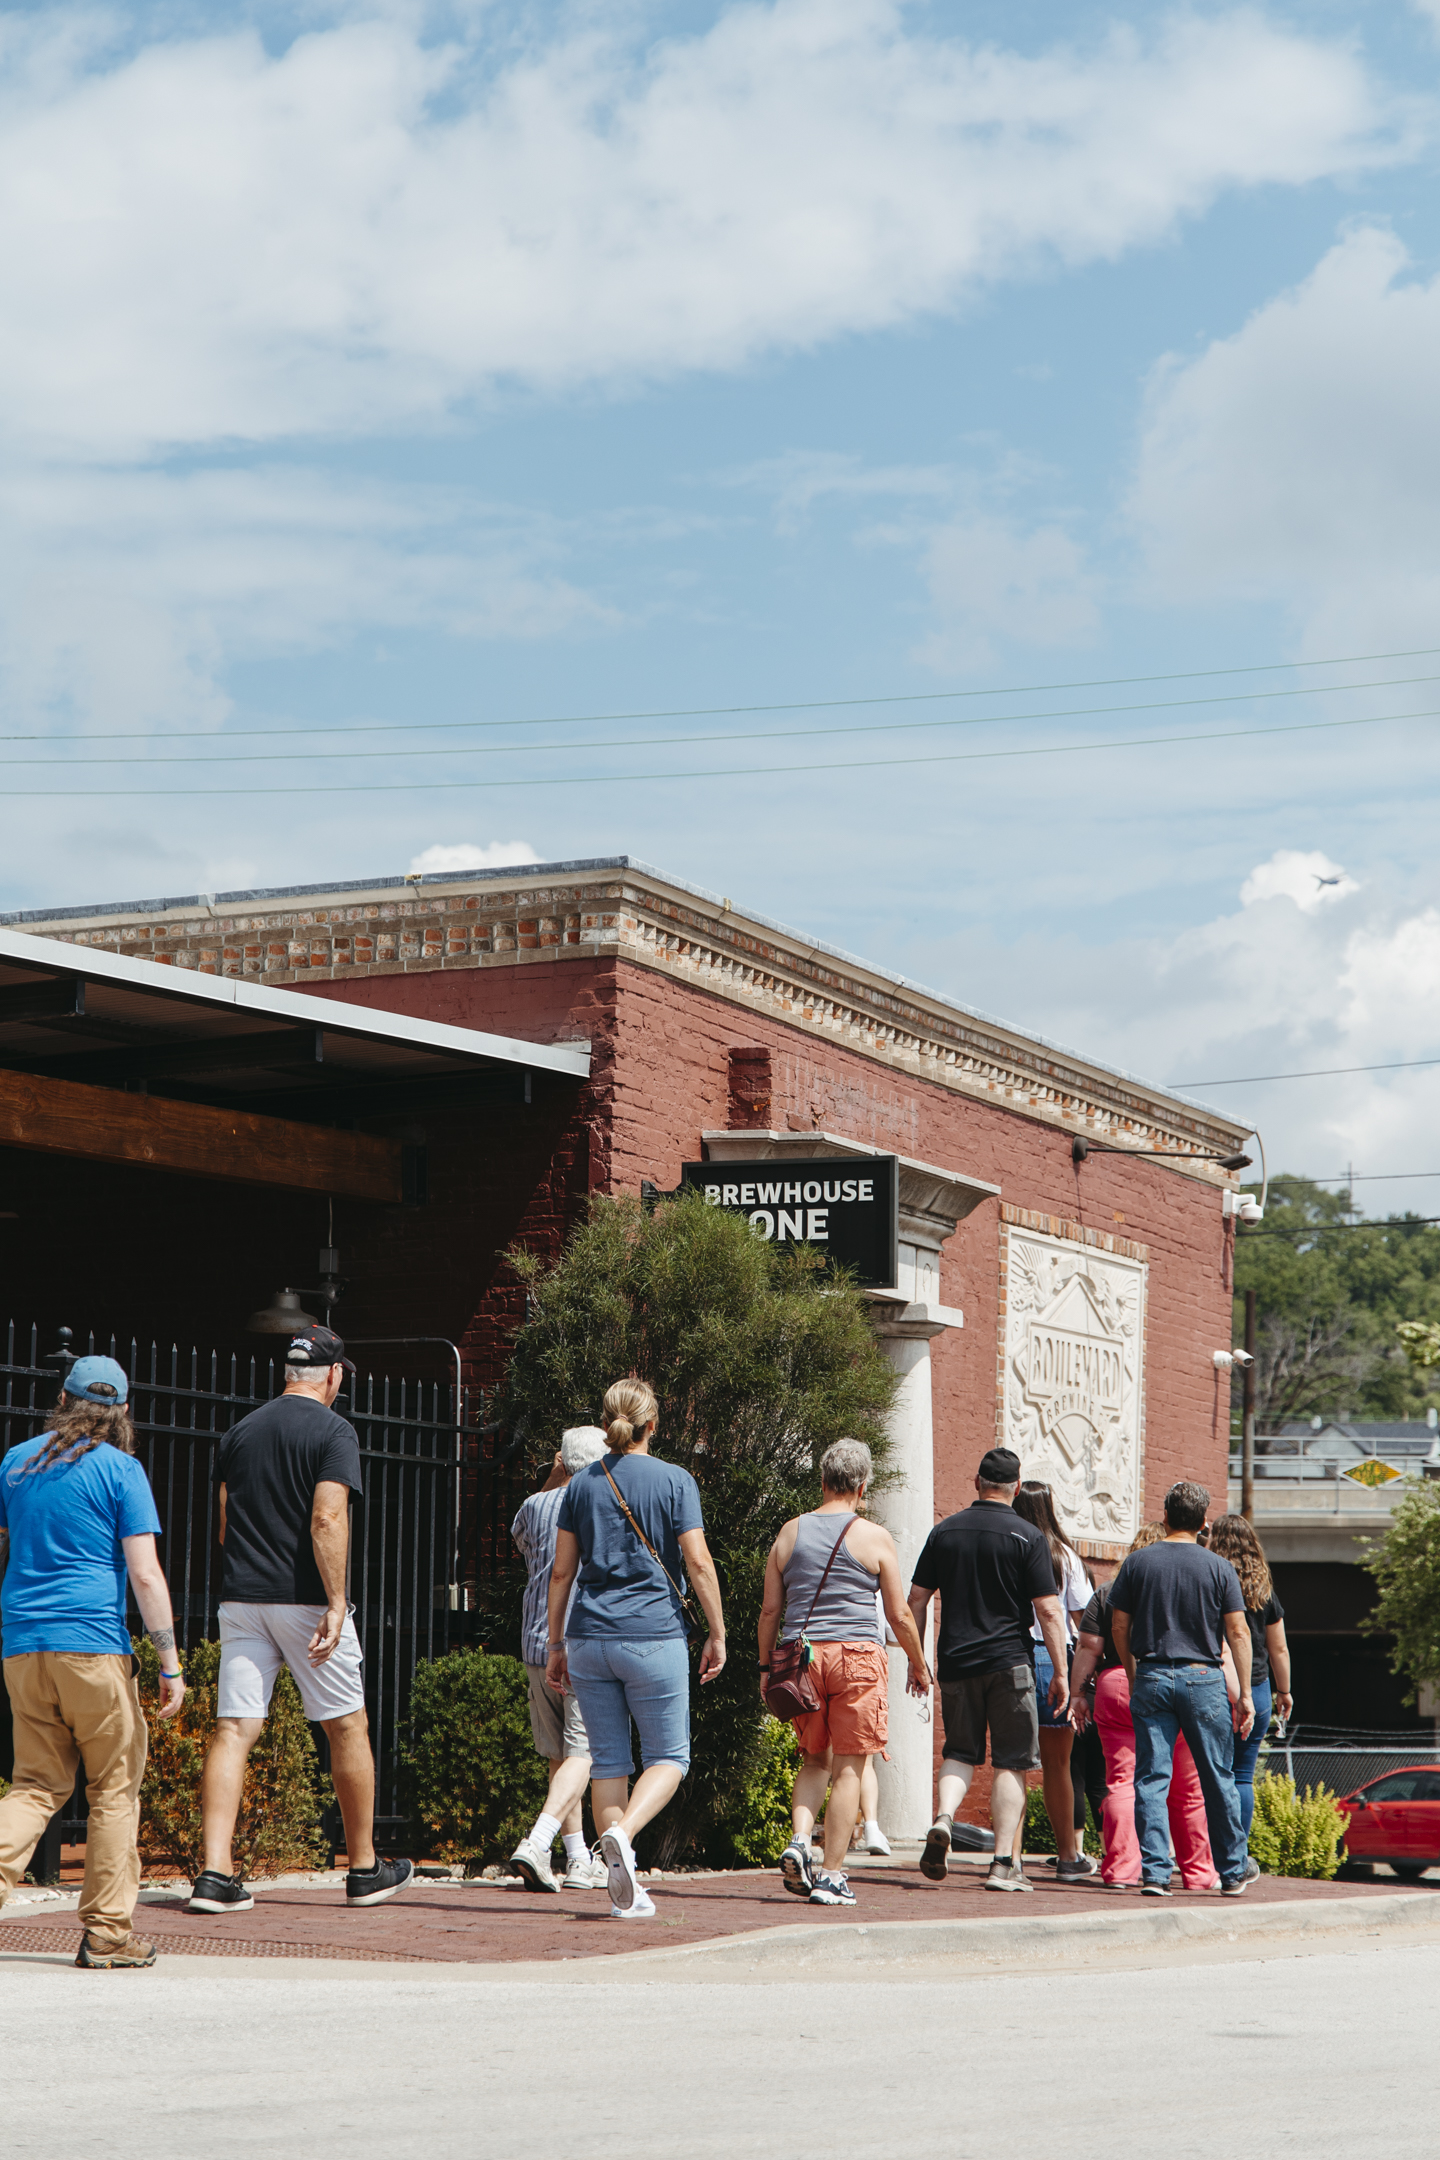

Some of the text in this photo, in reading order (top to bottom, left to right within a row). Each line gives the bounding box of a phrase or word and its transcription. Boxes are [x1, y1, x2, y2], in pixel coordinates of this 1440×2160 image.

[704, 1179, 874, 1206] BREWHOUSE
[749, 1208, 829, 1241] ONE
[1033, 1335, 1120, 1398] BOULEVARD
[1046, 1393, 1095, 1424] BREWING
